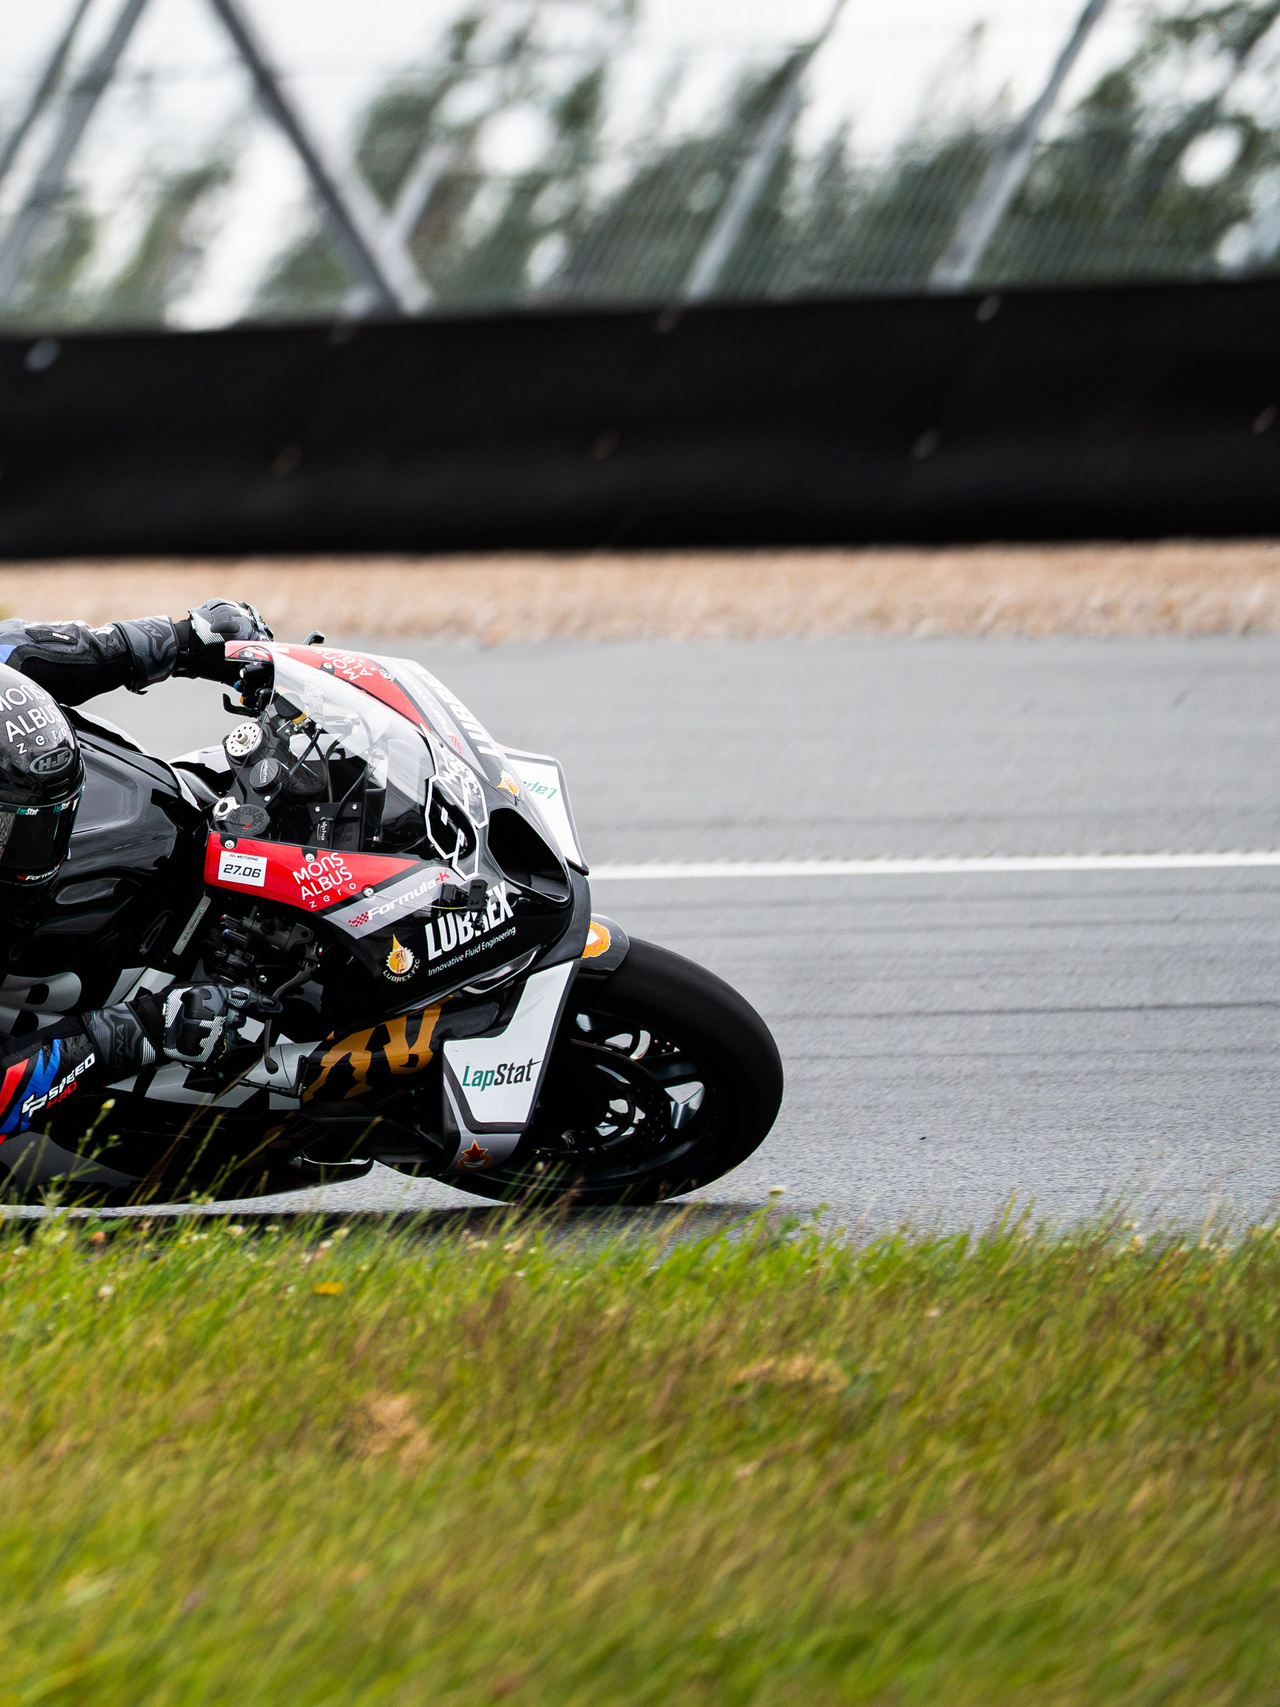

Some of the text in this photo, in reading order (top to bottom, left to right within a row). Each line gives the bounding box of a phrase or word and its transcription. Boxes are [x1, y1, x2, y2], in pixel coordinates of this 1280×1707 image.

[4, 704, 62, 743] ALBUS
[223, 863, 262, 879] 27.06
[293, 851, 344, 885] MONS
[300, 866, 353, 901] ALBUS
[368, 869, 451, 921] Formula-K
[428, 926, 517, 977] Innovative Fluid Engineering
[462, 1058, 543, 1092] LapStat
